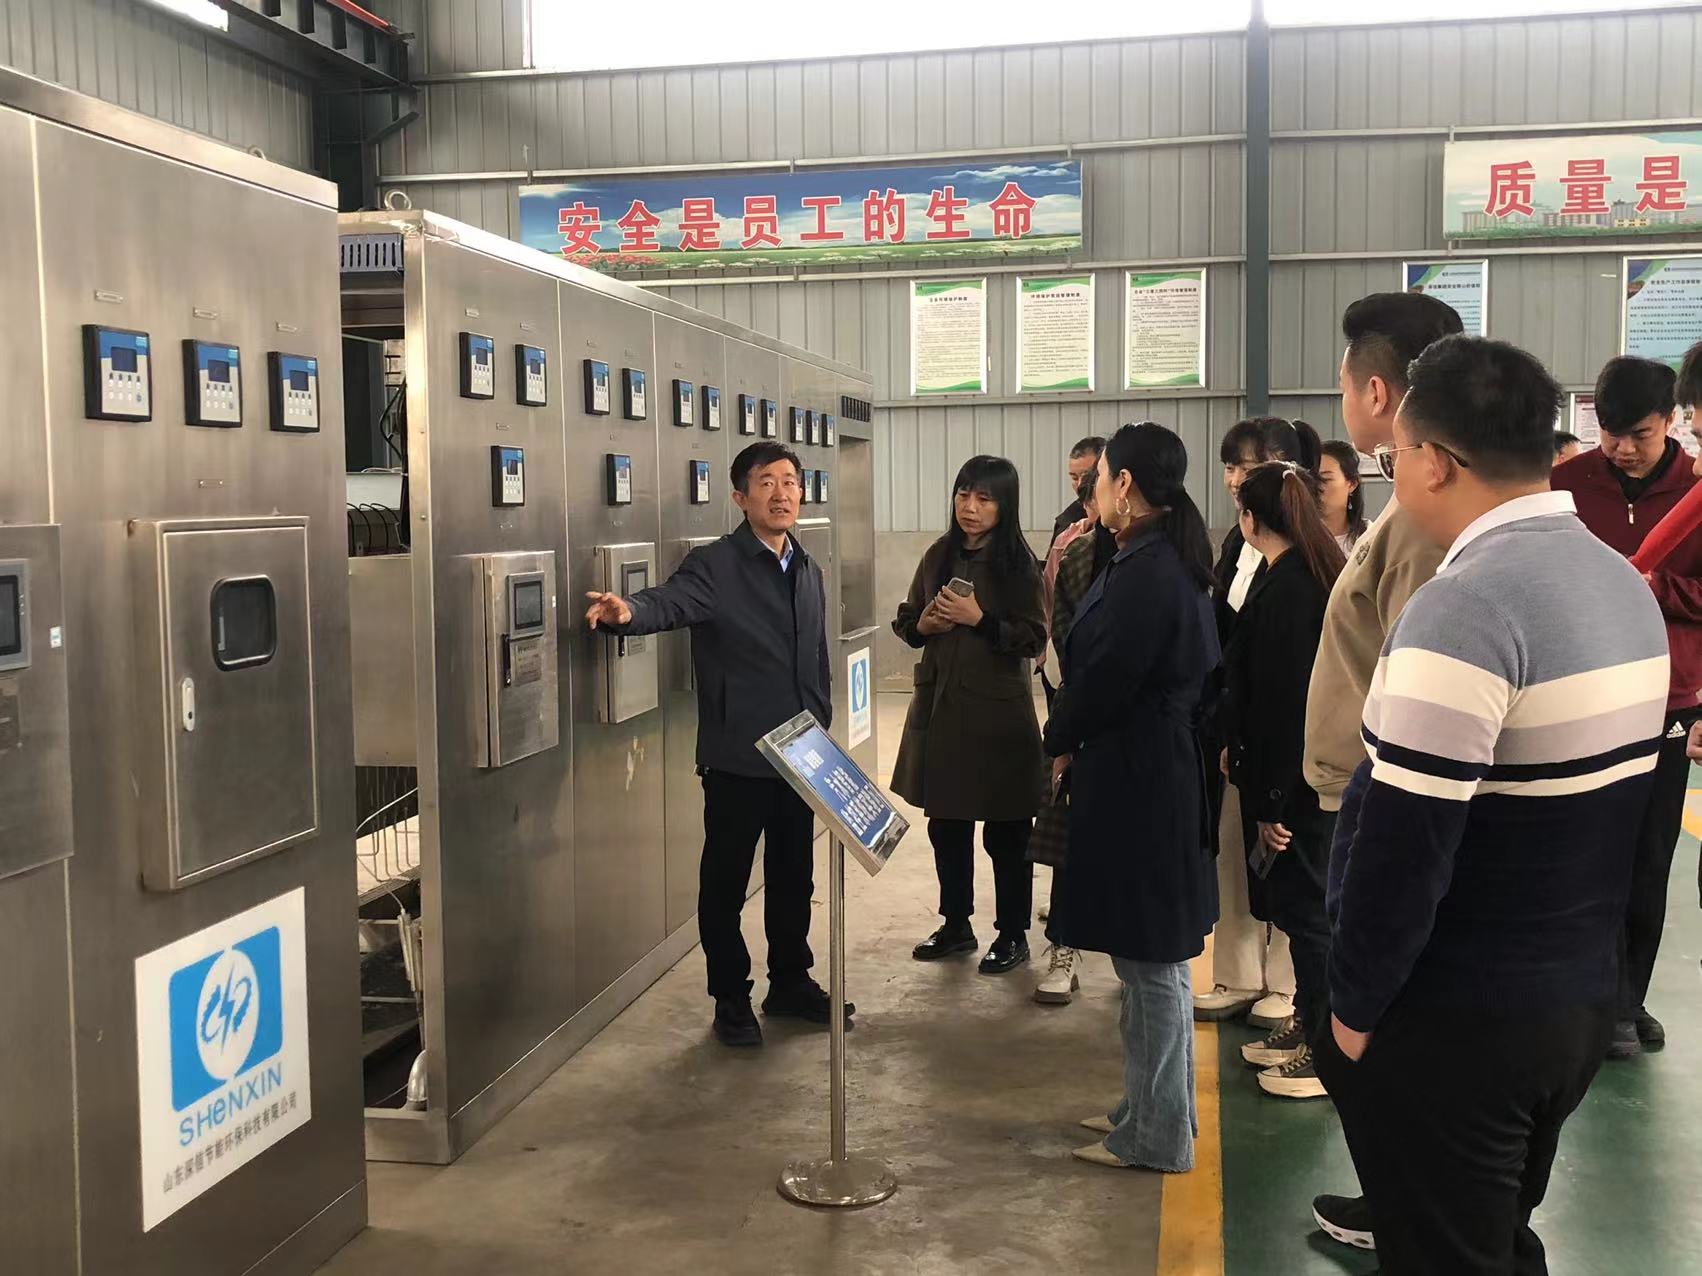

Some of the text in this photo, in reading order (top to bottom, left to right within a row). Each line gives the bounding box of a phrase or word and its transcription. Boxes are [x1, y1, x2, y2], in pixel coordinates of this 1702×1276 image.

[557, 180, 1038, 256] 安全是员工的生命
[1484, 154, 1689, 218] 质量是
